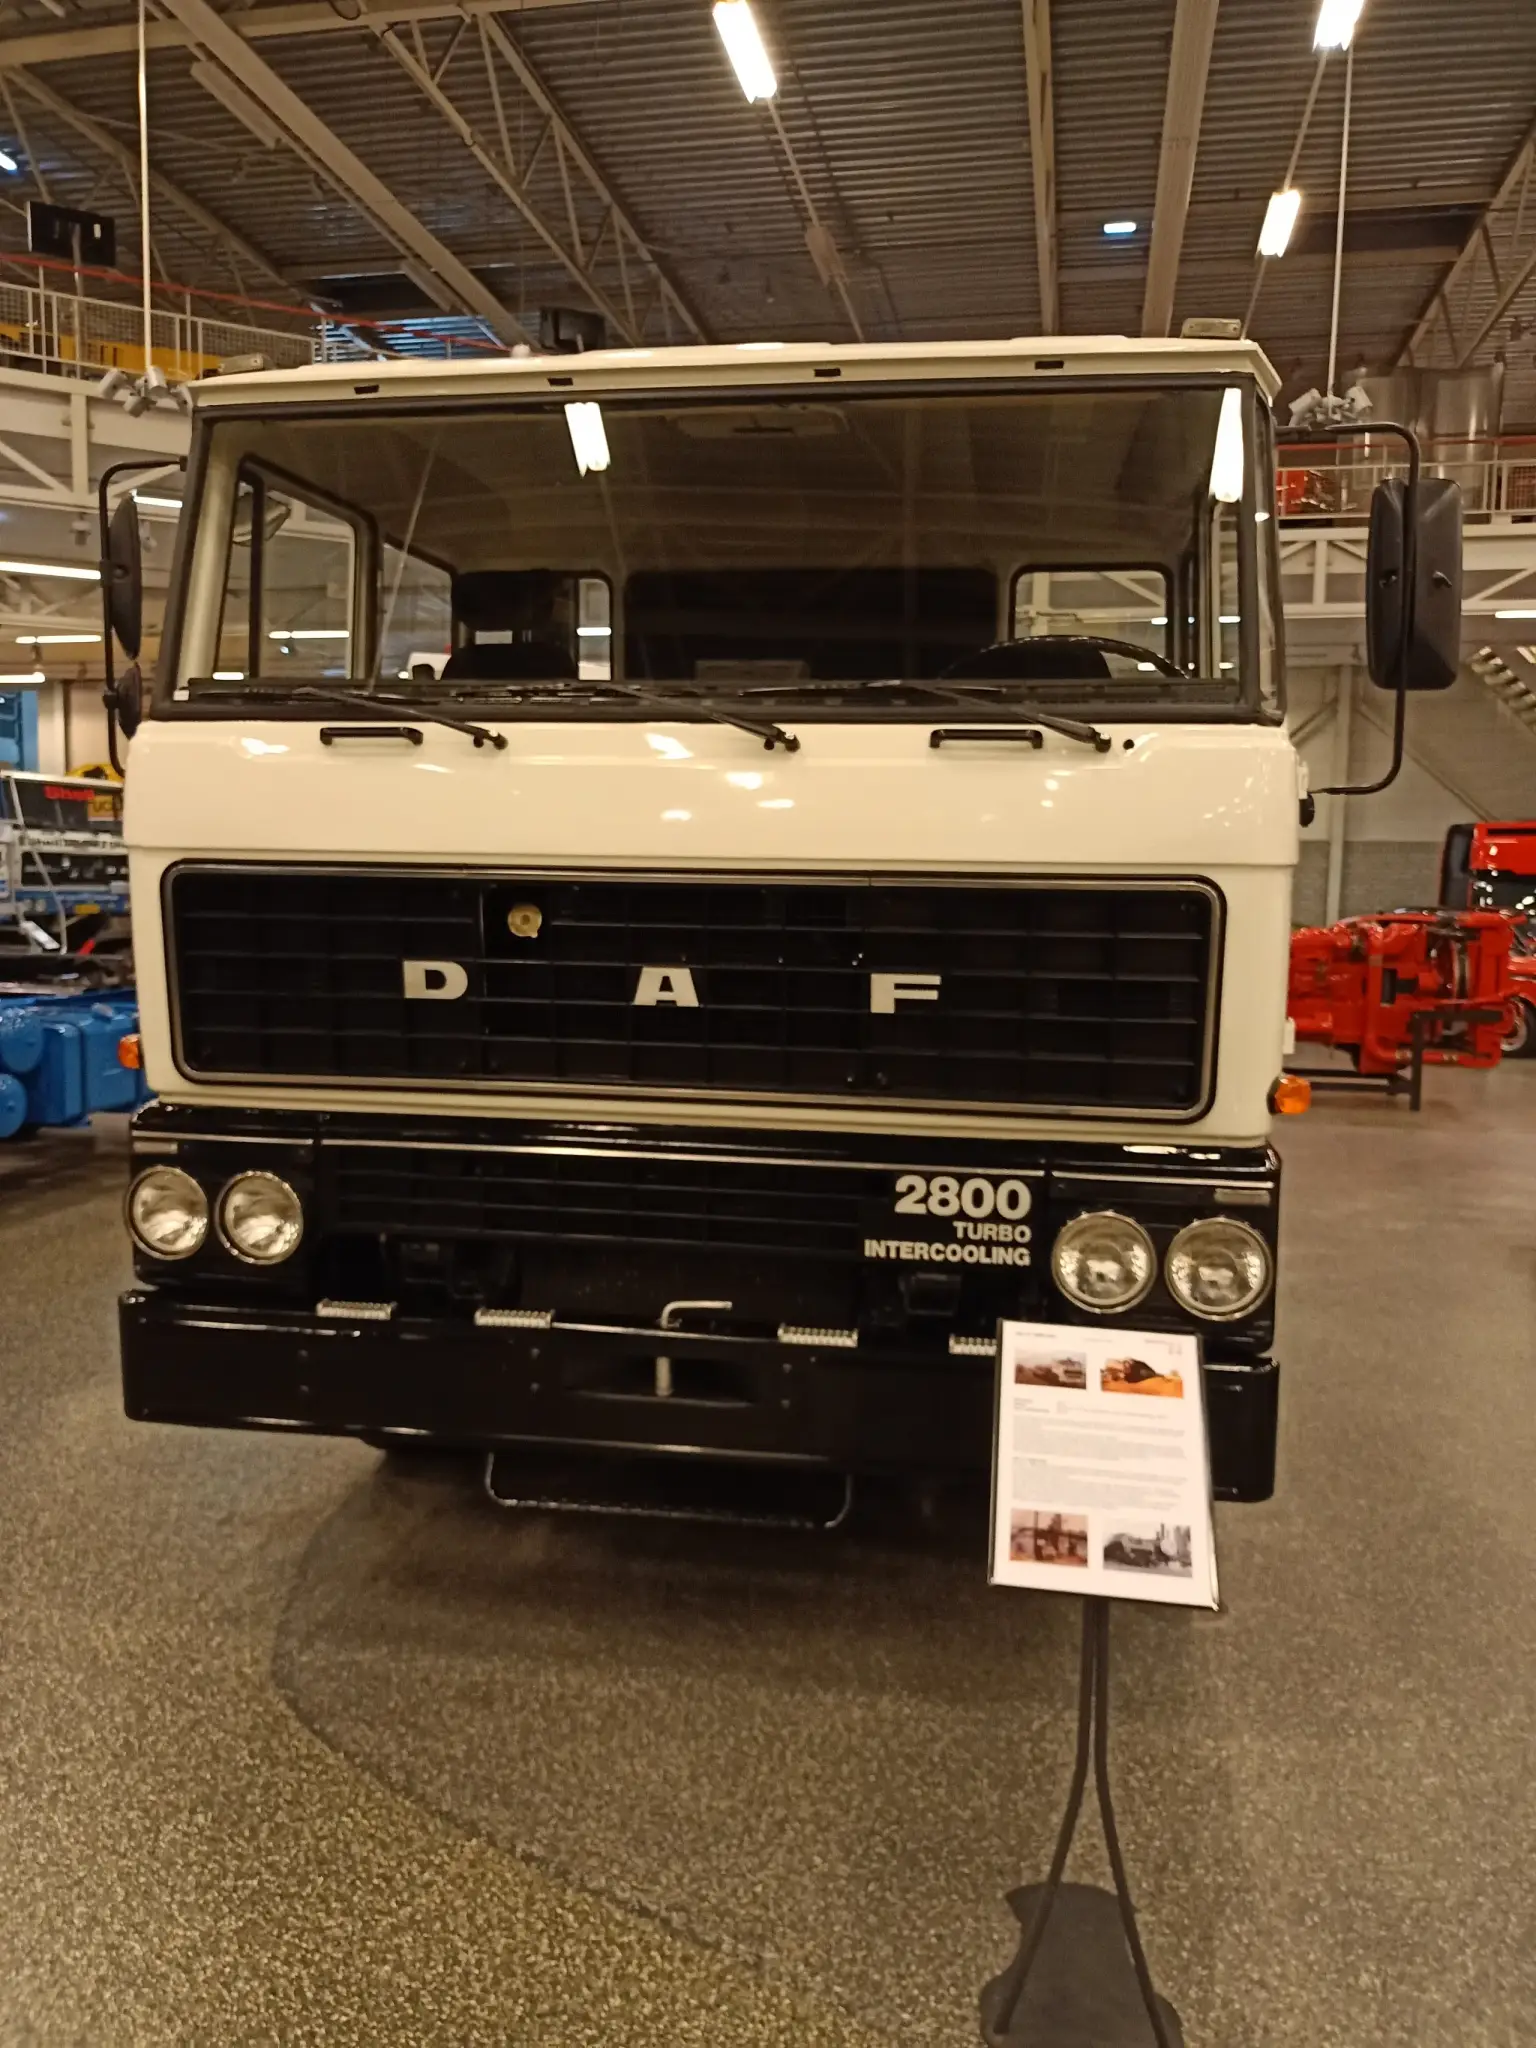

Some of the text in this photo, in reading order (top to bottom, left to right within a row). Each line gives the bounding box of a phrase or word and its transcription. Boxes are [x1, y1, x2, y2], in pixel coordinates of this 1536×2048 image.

[895, 1174, 1032, 1220] 2800
[953, 1221, 1032, 1243] TURBO
[864, 1239, 1031, 1267] INTERCOOLING
